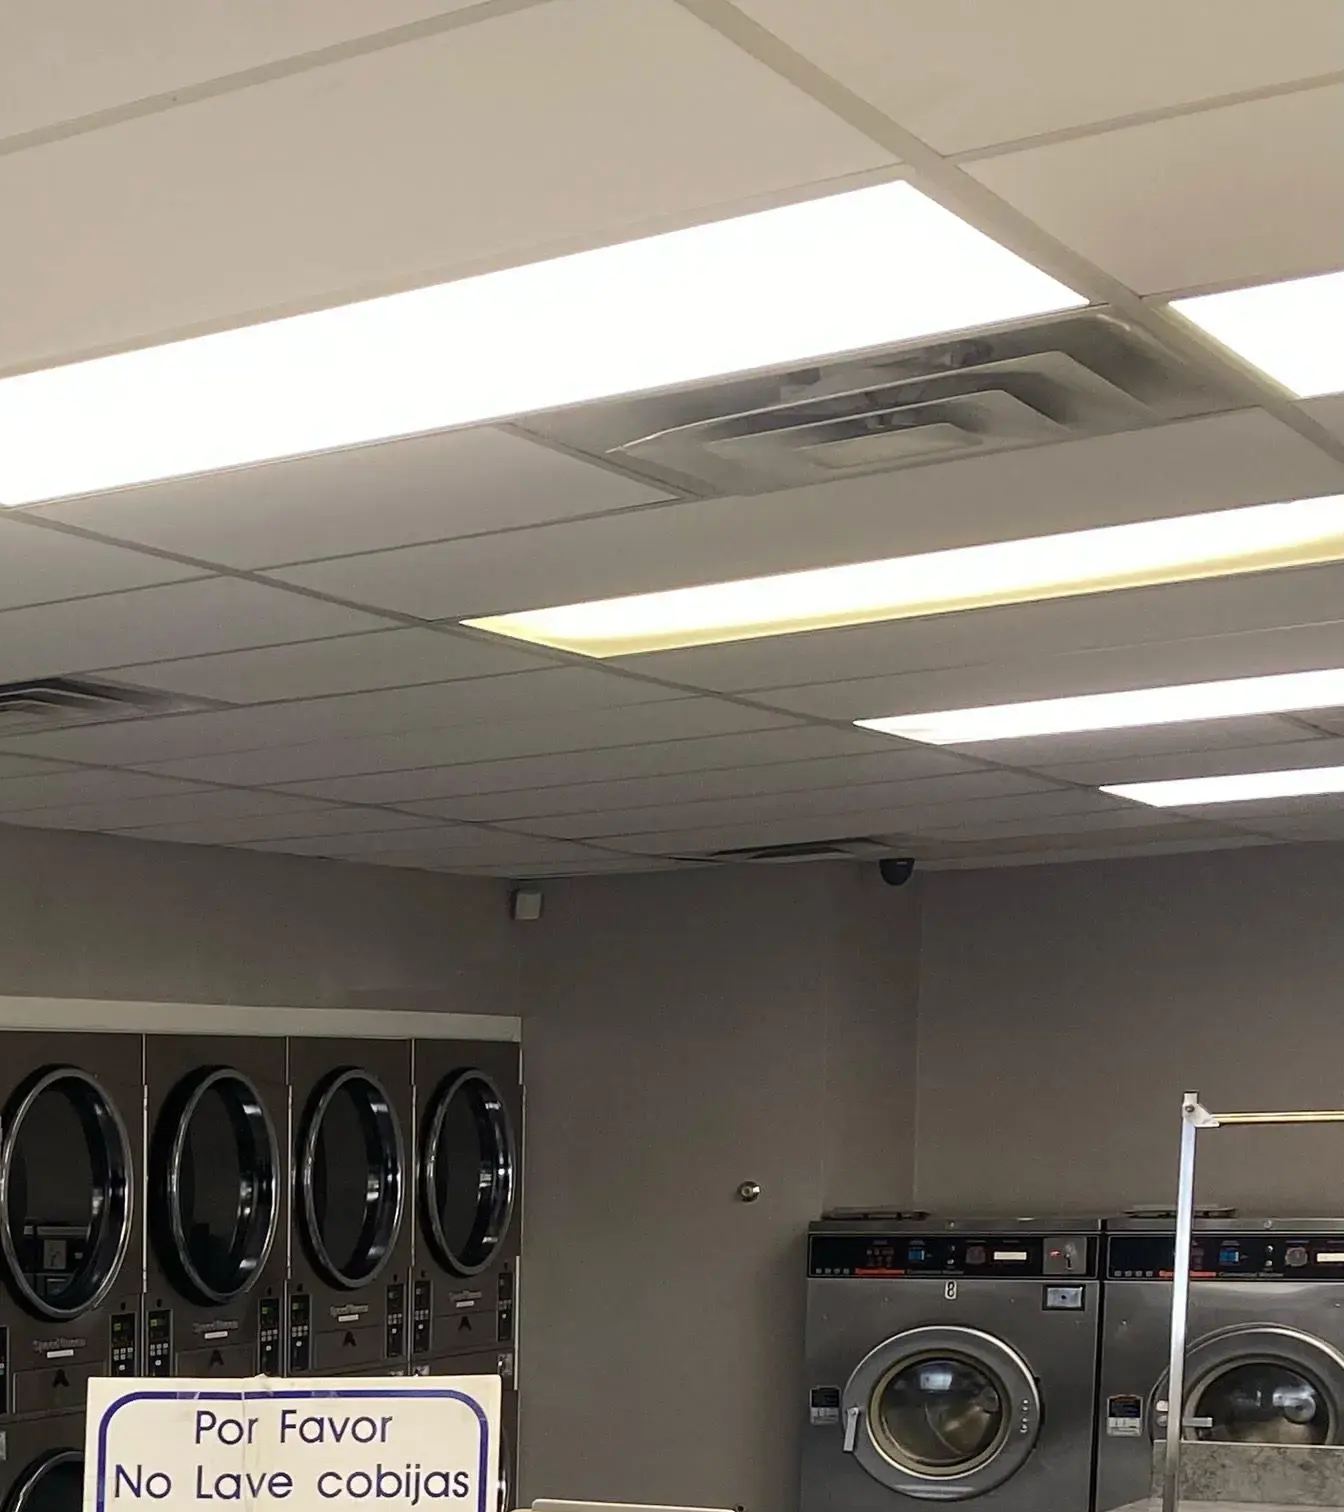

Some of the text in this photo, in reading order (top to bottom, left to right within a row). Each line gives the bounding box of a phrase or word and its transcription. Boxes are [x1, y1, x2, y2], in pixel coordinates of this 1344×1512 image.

[946, 1281, 956, 1298] 8
[195, 1409, 393, 1444] Por Favor
[114, 1463, 470, 1505] No Lave cobijas
